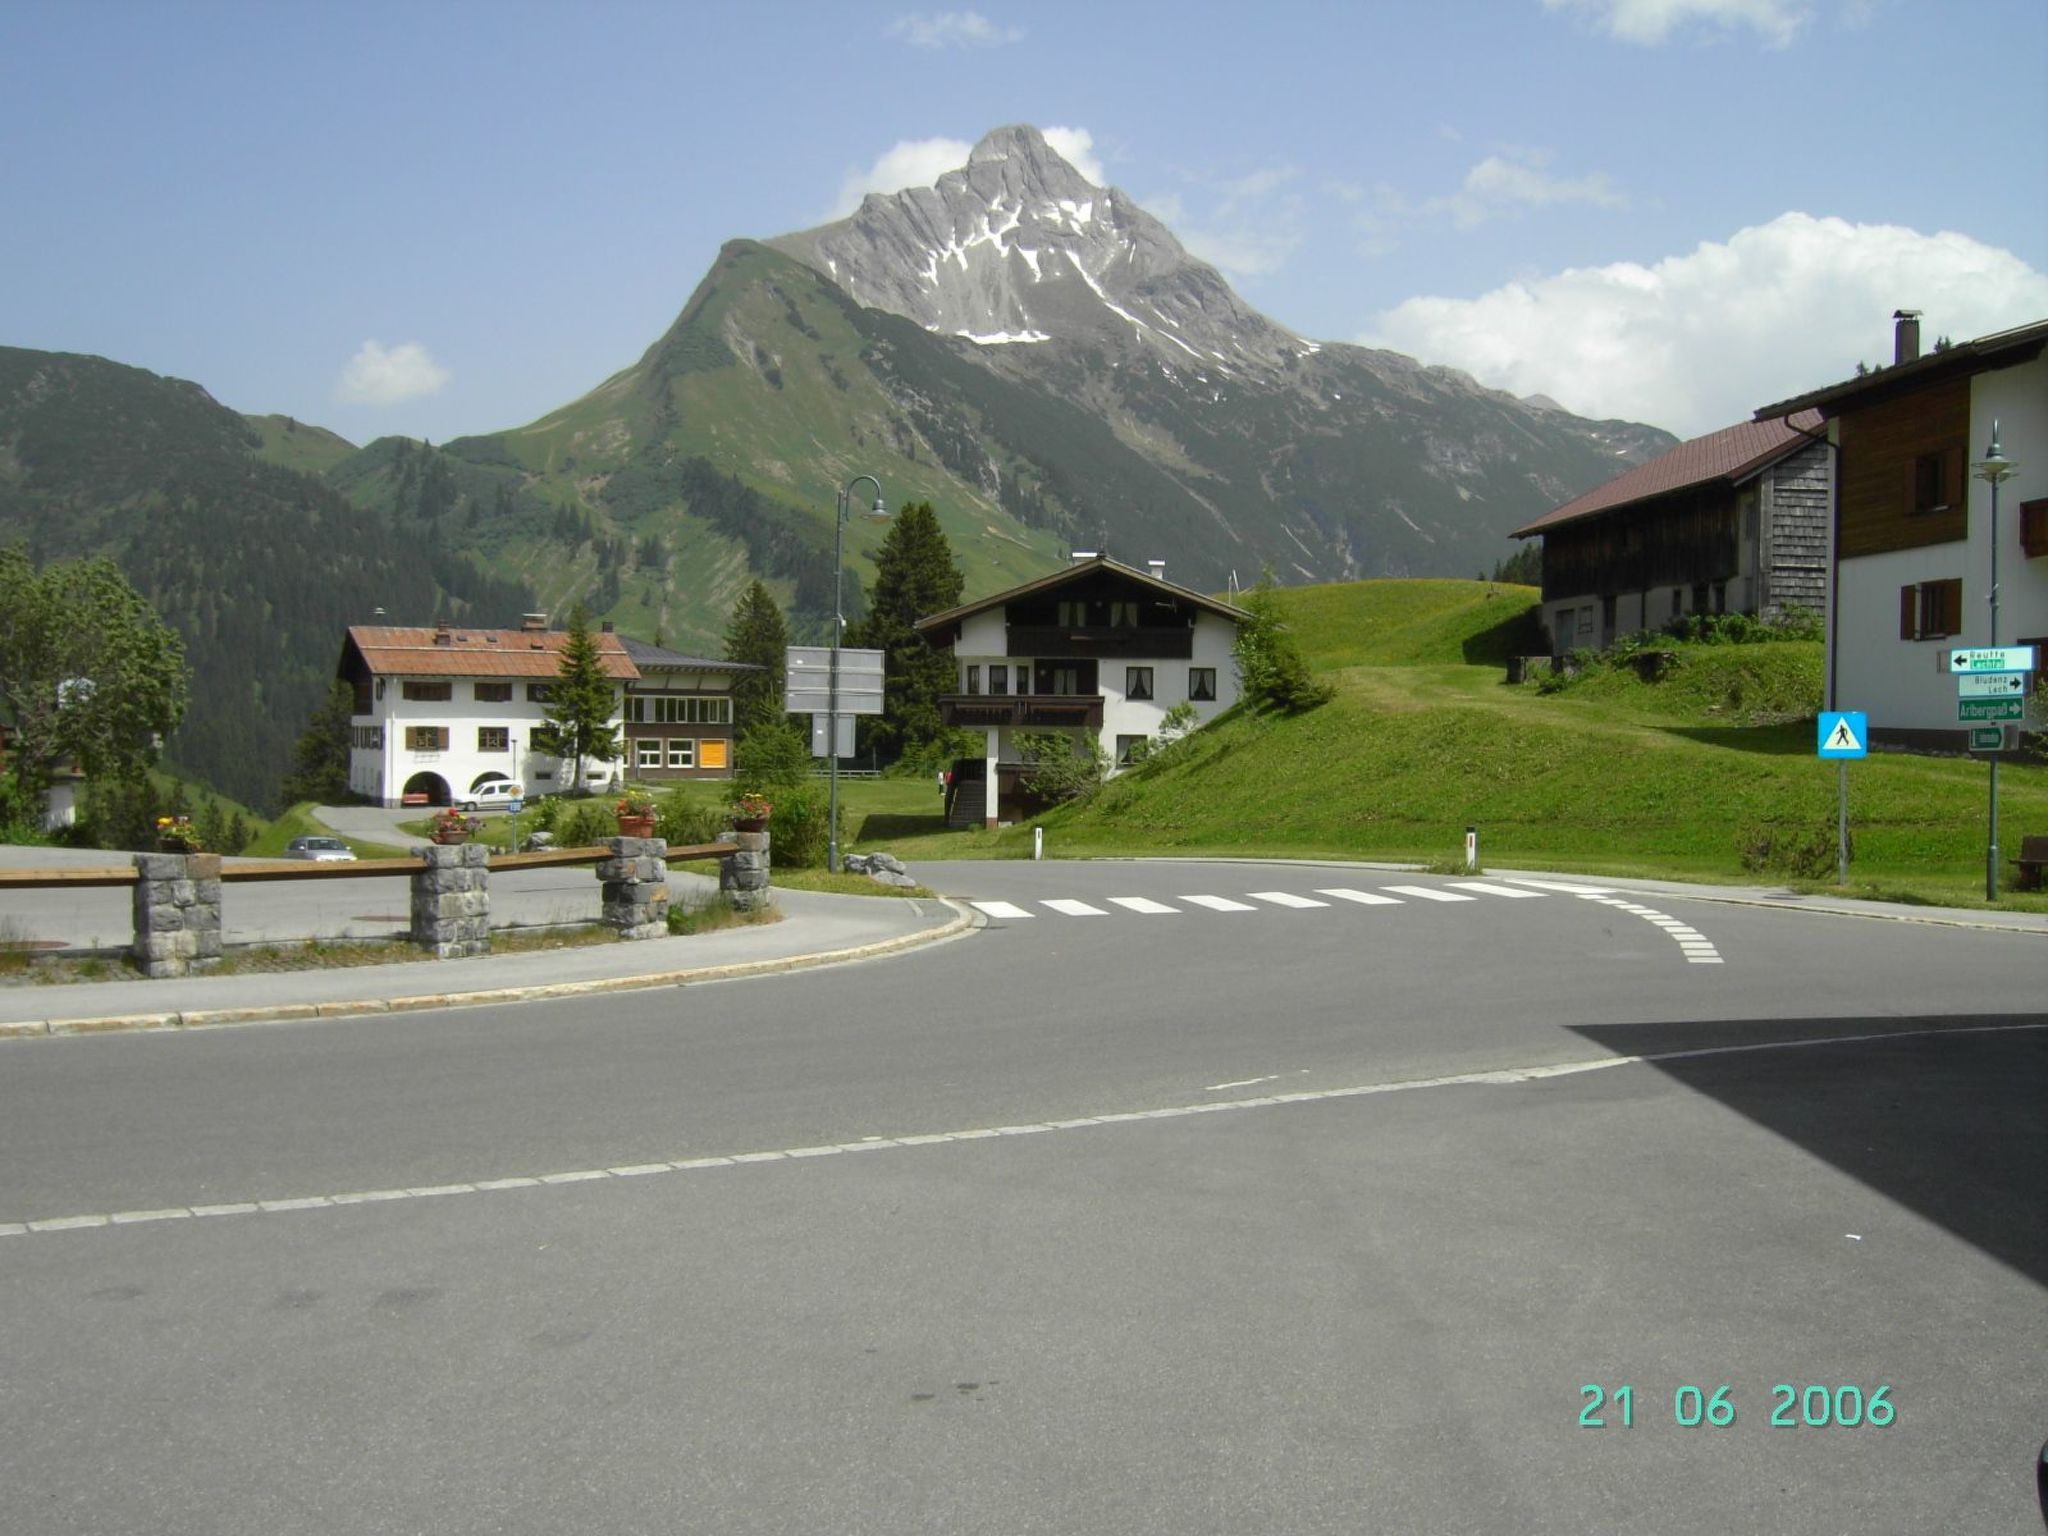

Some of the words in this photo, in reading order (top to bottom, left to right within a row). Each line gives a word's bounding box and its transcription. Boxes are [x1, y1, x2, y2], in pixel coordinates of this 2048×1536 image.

[1970, 650, 2005, 659] Reutte
[1975, 676, 2008, 684] Bludenz
[1988, 685, 2008, 694] Lech
[1960, 702, 2008, 719] Arlbergpaß
